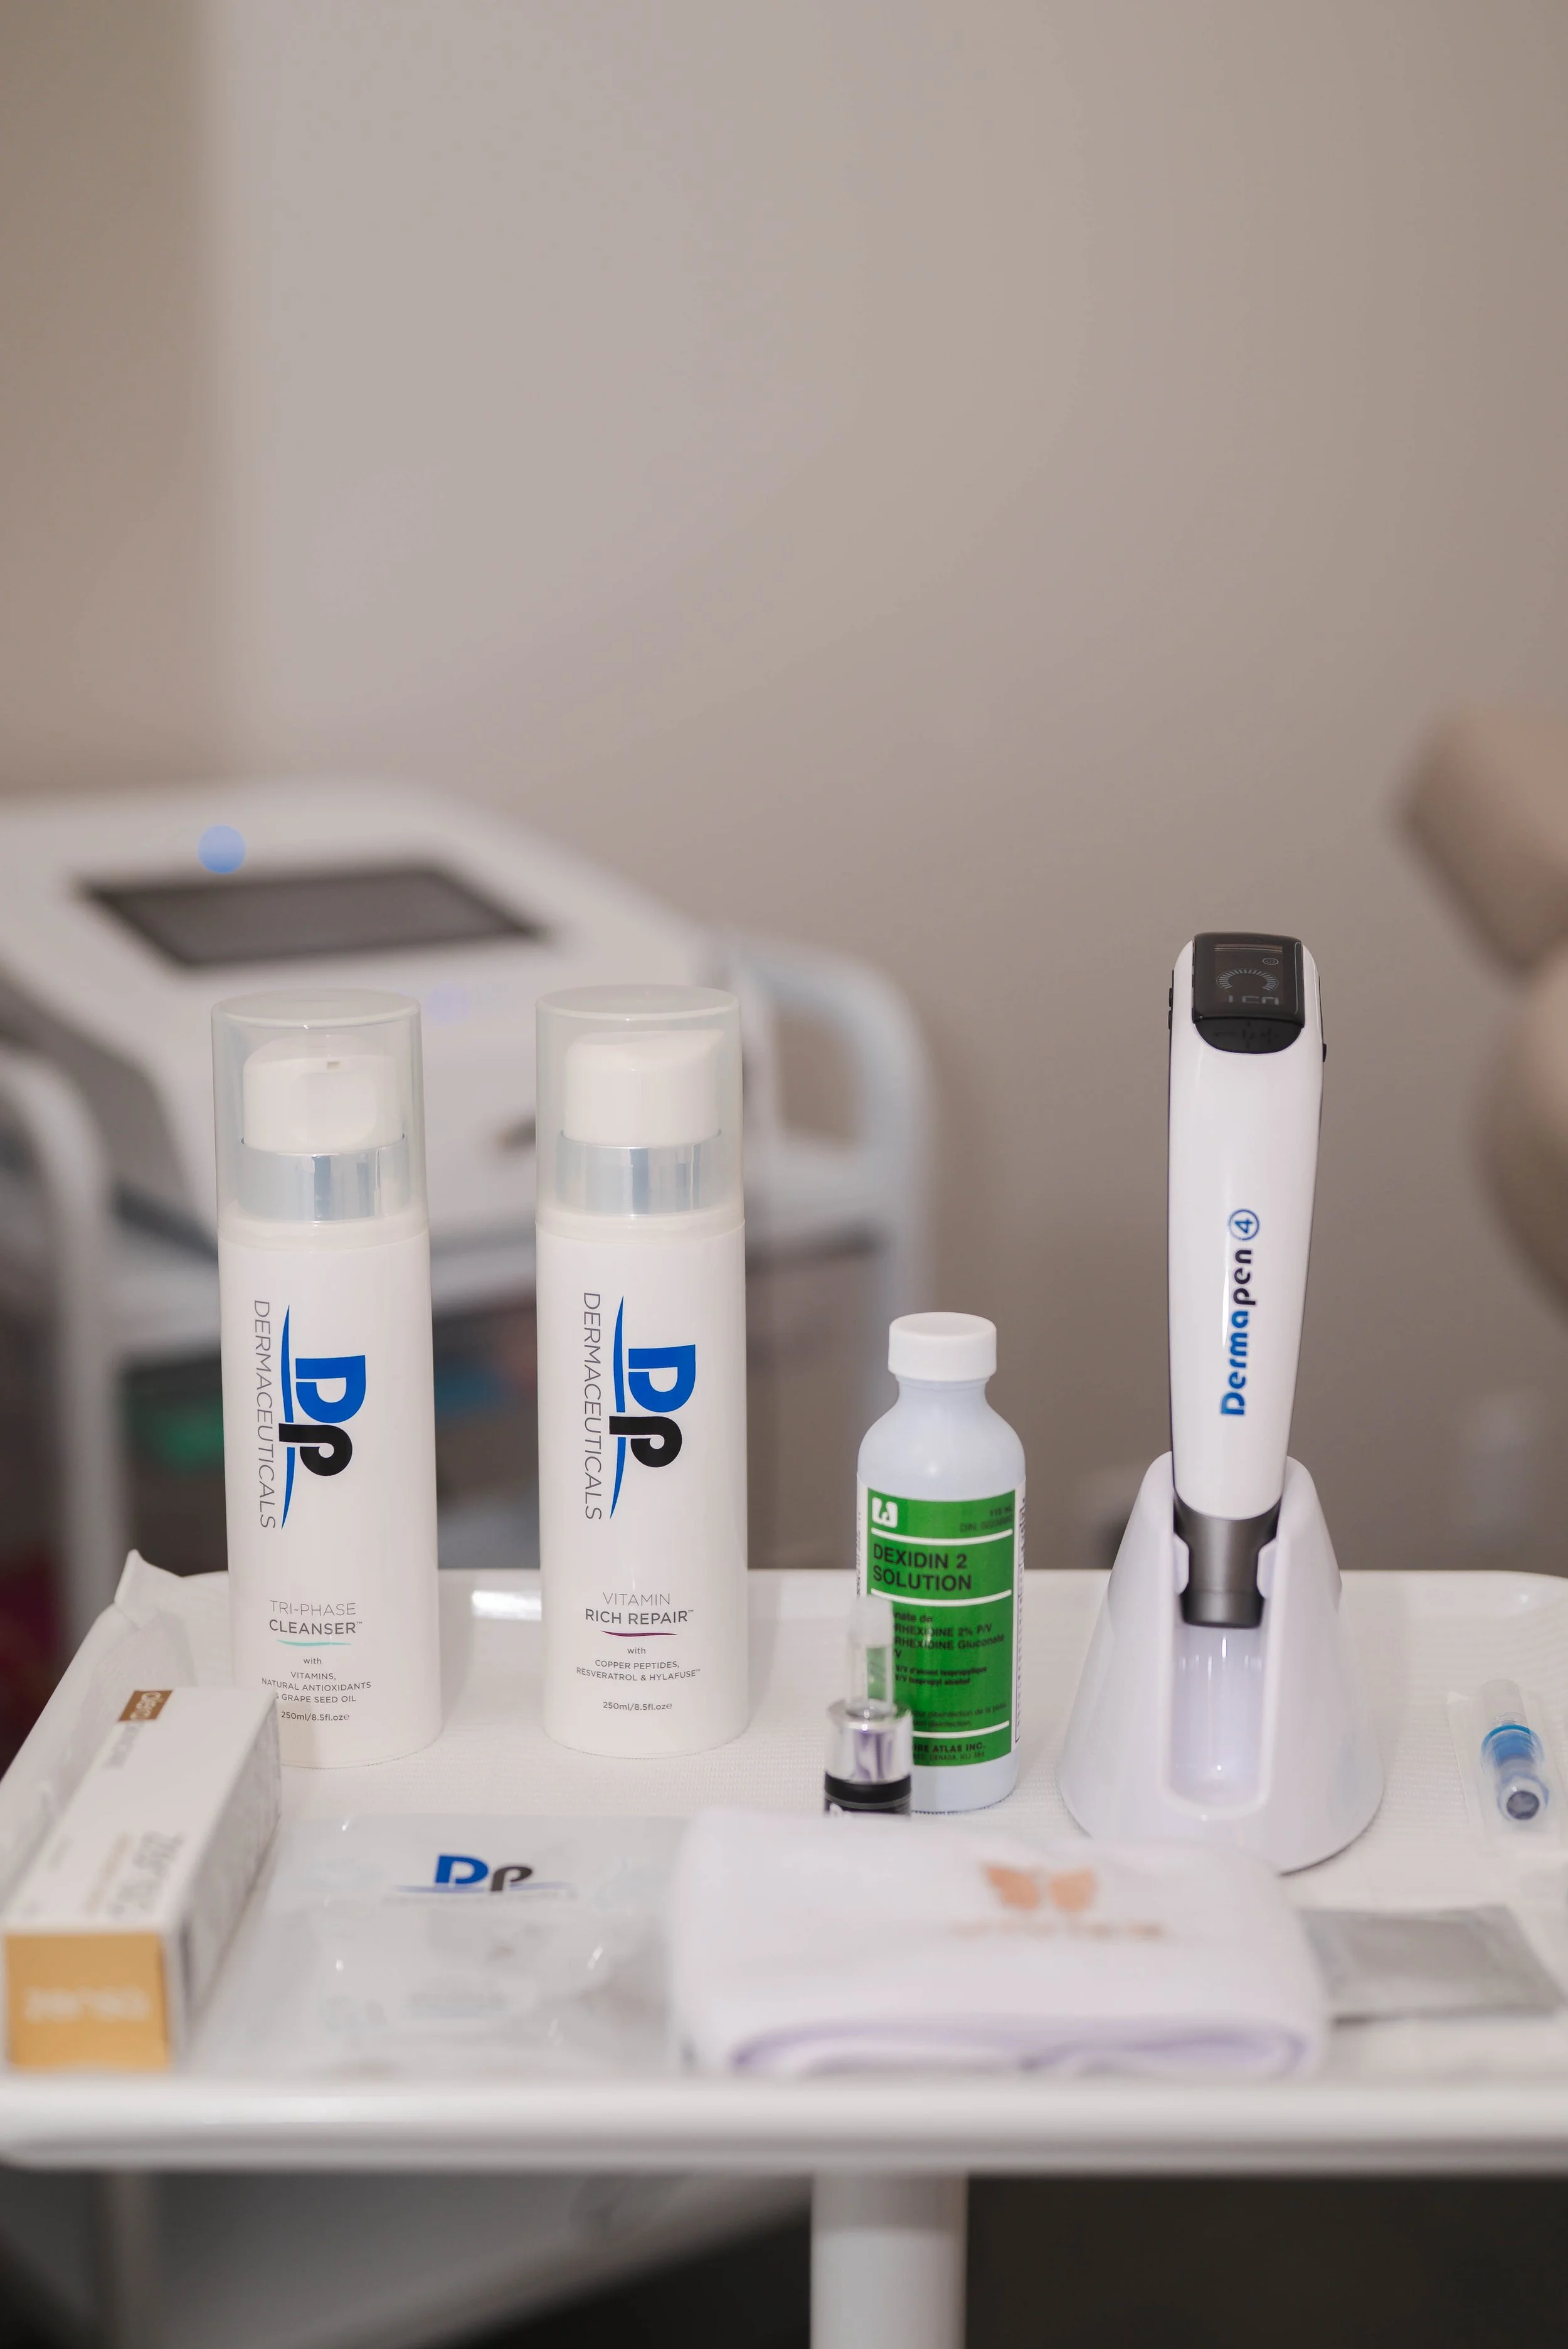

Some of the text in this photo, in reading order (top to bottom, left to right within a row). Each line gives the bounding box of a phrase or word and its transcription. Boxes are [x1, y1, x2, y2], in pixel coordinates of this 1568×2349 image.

[1221, 1249, 1257, 1416] Dermapen
[583, 1292, 602, 1520] DERMACEUTICALS
[254, 1300, 276, 1529] DERMACEUTICALS
[873, 1543, 967, 1569] DEXIDIN 2
[872, 1565, 972, 1591] SOLUTION
[602, 1592, 670, 1606] VITAMIN
[270, 1599, 356, 1616] TRI-PHASE
[585, 1608, 622, 1625] RICH
[894, 1623, 954, 1638] RHEXIDINE
[894, 1635, 954, 1651] RHEXIDINE
[595, 1659, 680, 1670] COPPER PEPTIDES,
[290, 1671, 336, 1680] VITAMINS,
[576, 1667, 638, 1682] RESVERATROL
[262, 1677, 371, 1692] NATURAL ANTIOXIDANTS
[282, 1694, 311, 1703] GRAPE
[314, 1695, 338, 1704] SEED
